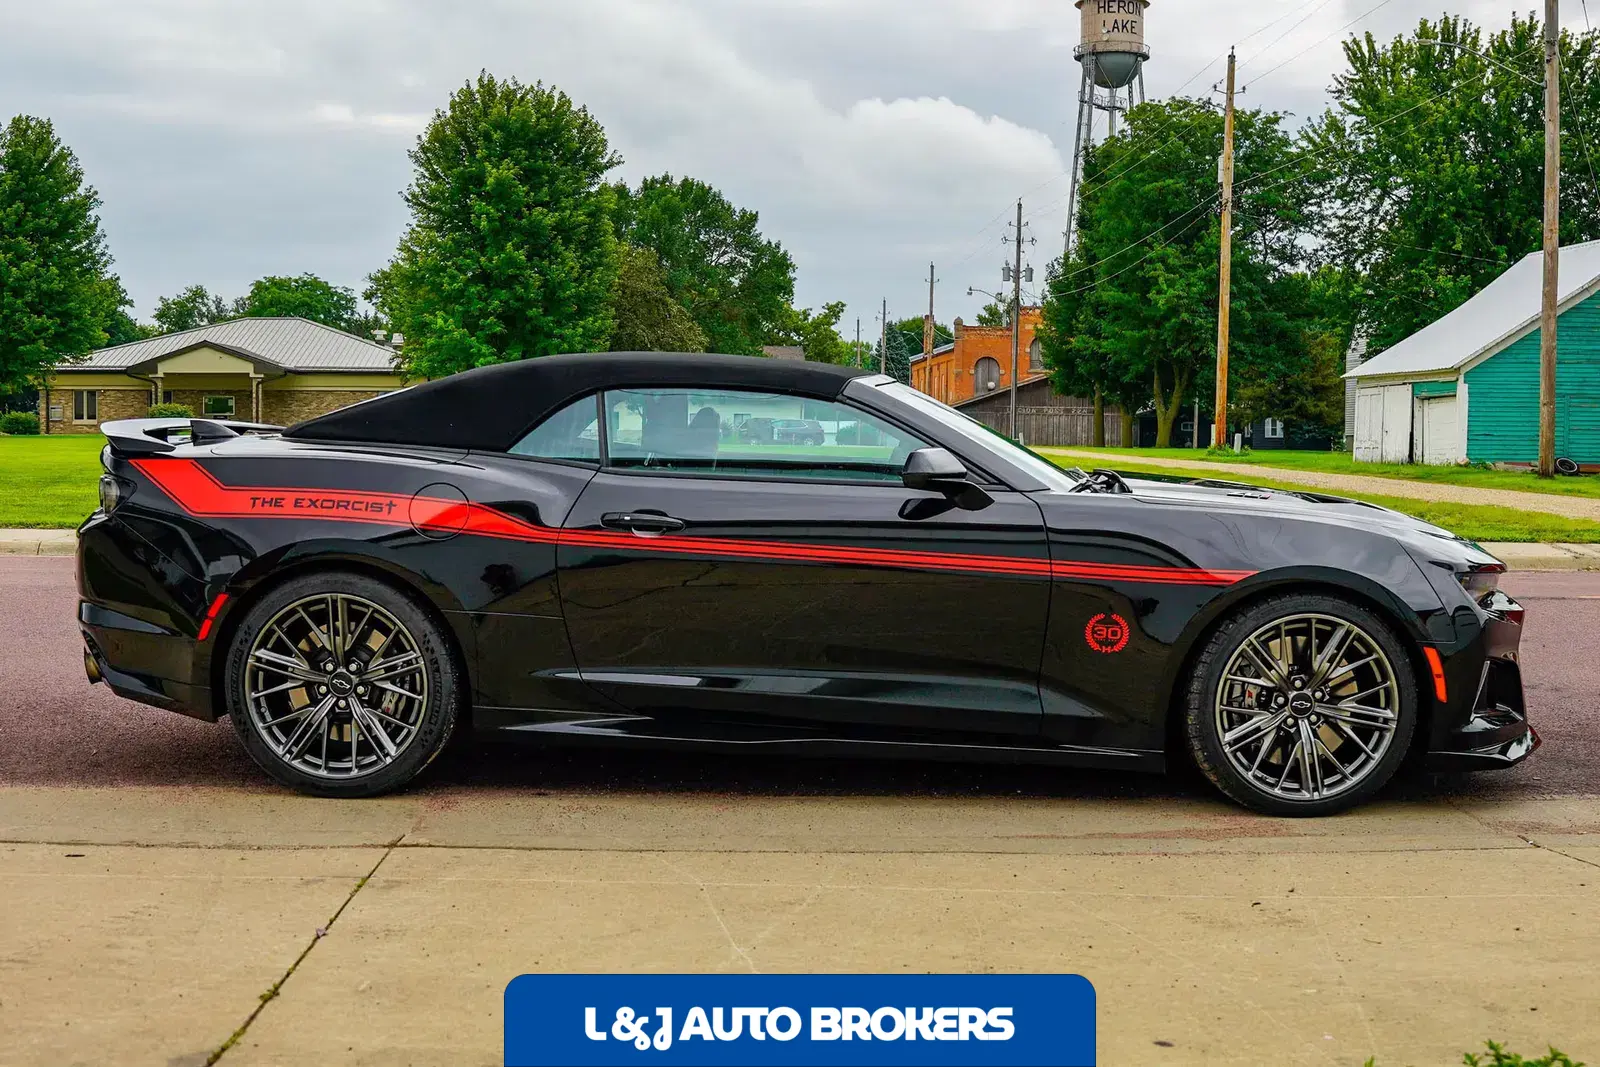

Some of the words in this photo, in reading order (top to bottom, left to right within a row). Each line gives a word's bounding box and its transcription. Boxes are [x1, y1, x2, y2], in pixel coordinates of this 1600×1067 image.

[1097, 0, 1141, 16] HERON
[1103, 19, 1137, 35] LAKE
[250, 496, 286, 509] THE
[293, 497, 398, 516] EXORCIST
[1093, 626, 1122, 640] 30
